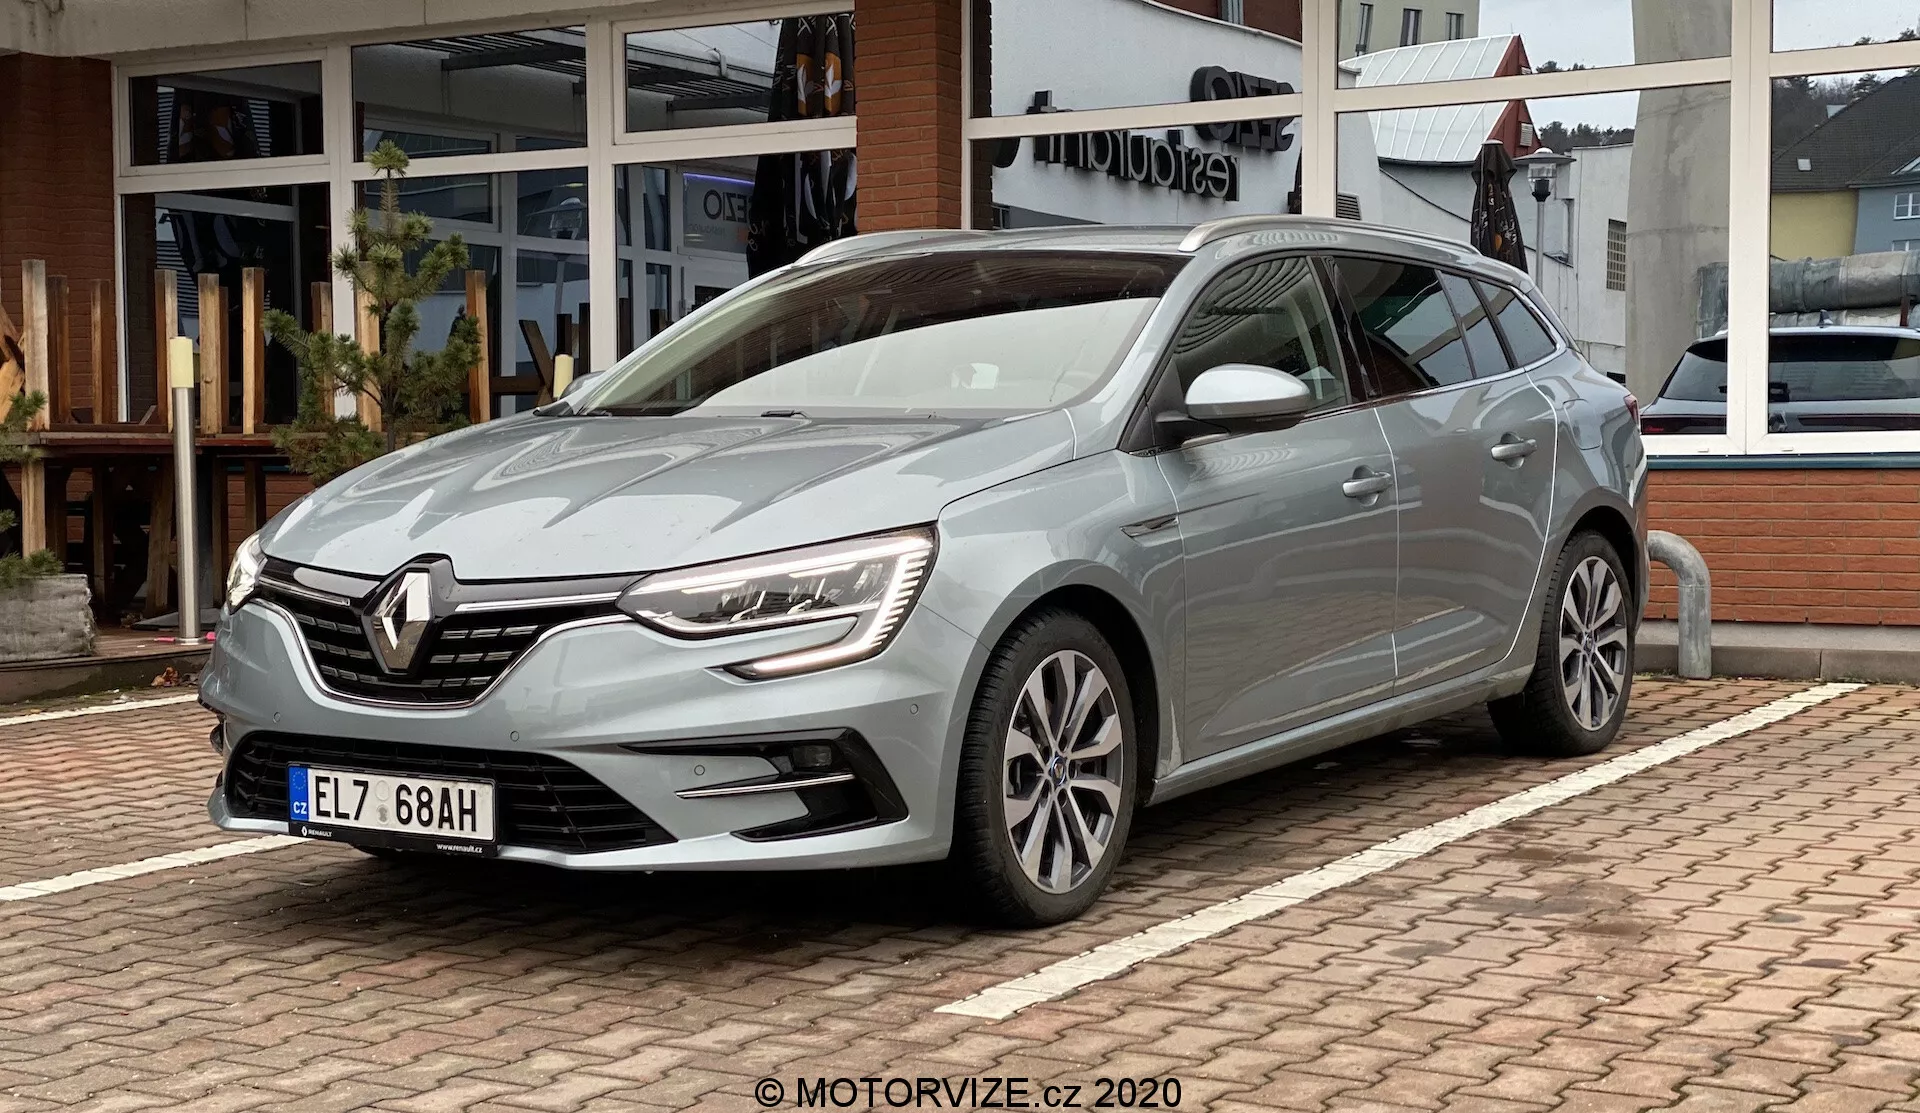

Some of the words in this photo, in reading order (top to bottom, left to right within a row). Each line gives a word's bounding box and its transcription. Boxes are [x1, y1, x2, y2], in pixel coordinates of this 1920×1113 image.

[293, 801, 308, 815] CZ
[315, 775, 369, 820] EL7
[395, 784, 476, 832] 68AH
[308, 829, 332, 837] RENAULT
